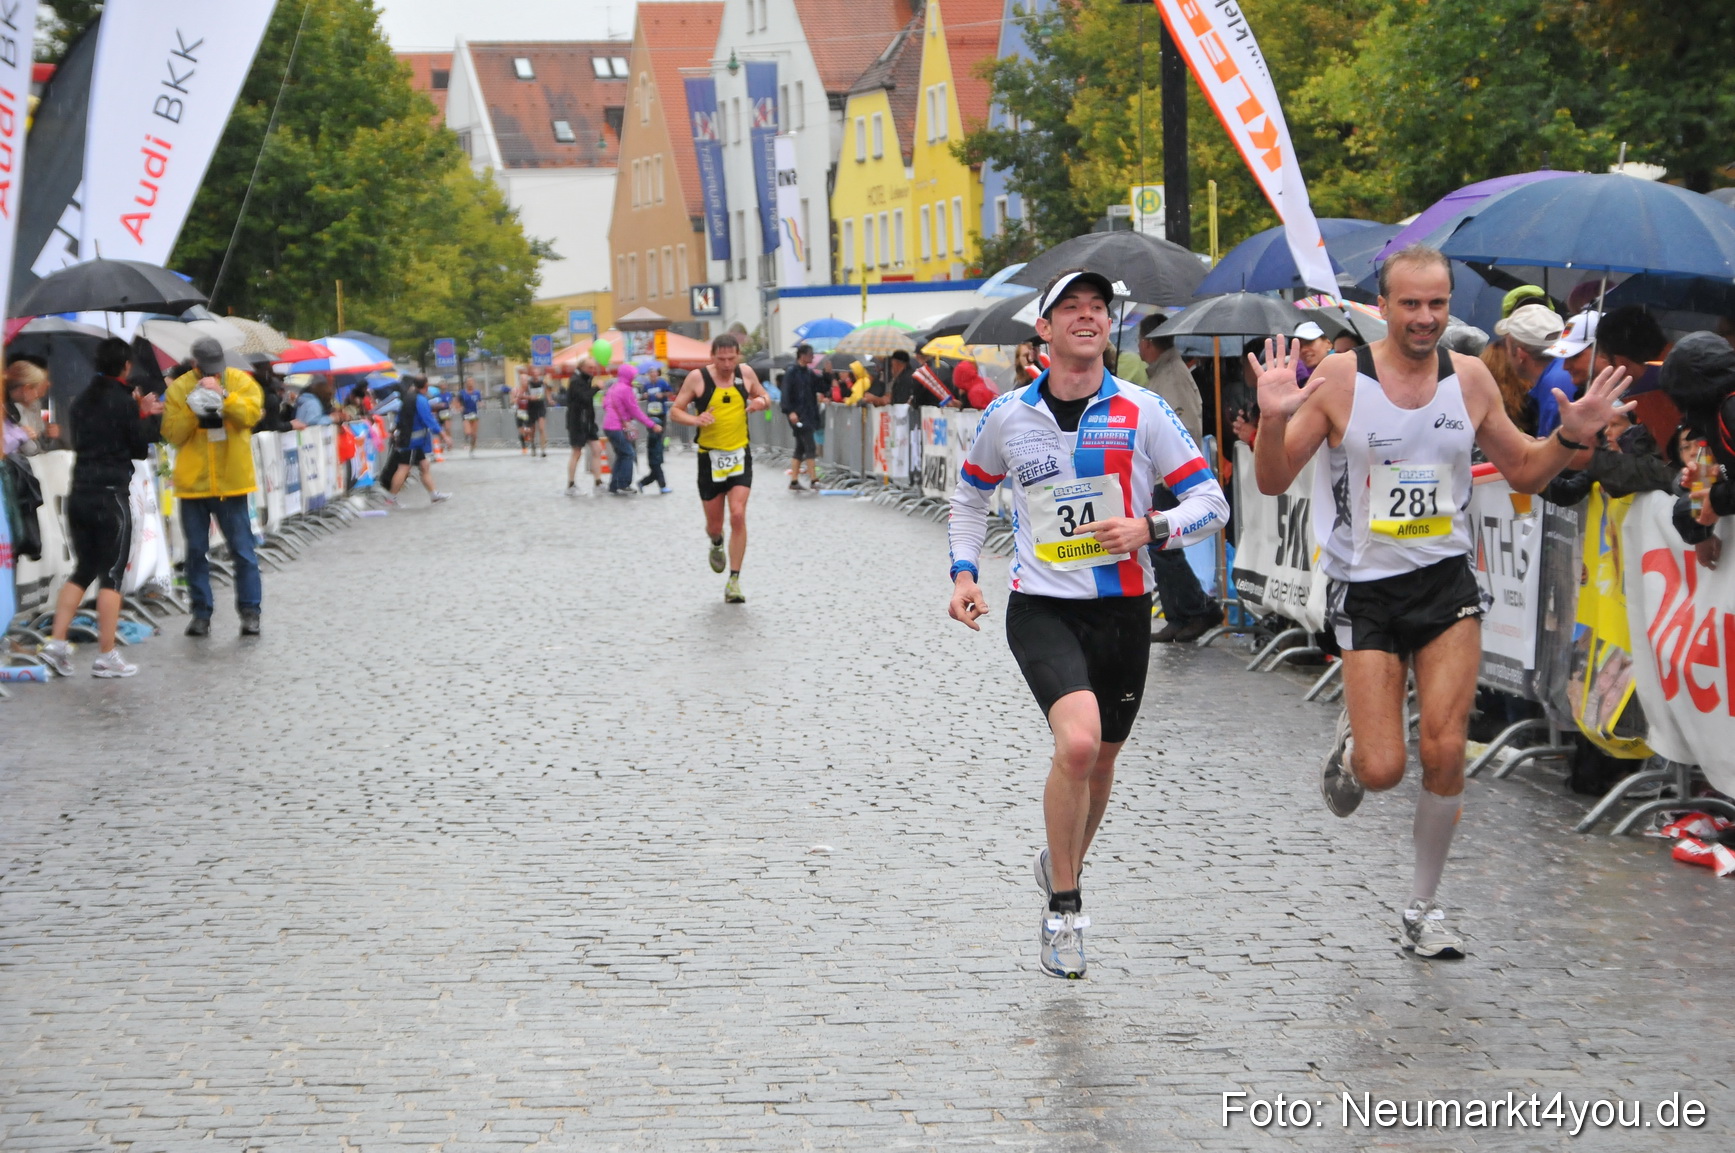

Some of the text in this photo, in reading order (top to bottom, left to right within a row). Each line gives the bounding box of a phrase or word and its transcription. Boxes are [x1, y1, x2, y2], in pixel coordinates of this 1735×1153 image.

[119, 28, 204, 246] Audi BKK
[1024, 437, 1042, 445] Schröder
[1083, 432, 1129, 441] LA CARRERA
[1018, 460, 1059, 483] PFEIFFER
[1053, 482, 1092, 497] BOCK
[1389, 486, 1439, 519] 281
[1057, 501, 1096, 537] 34
[1397, 522, 1430, 536] Alfons
[1057, 542, 1105, 559] Günthe
